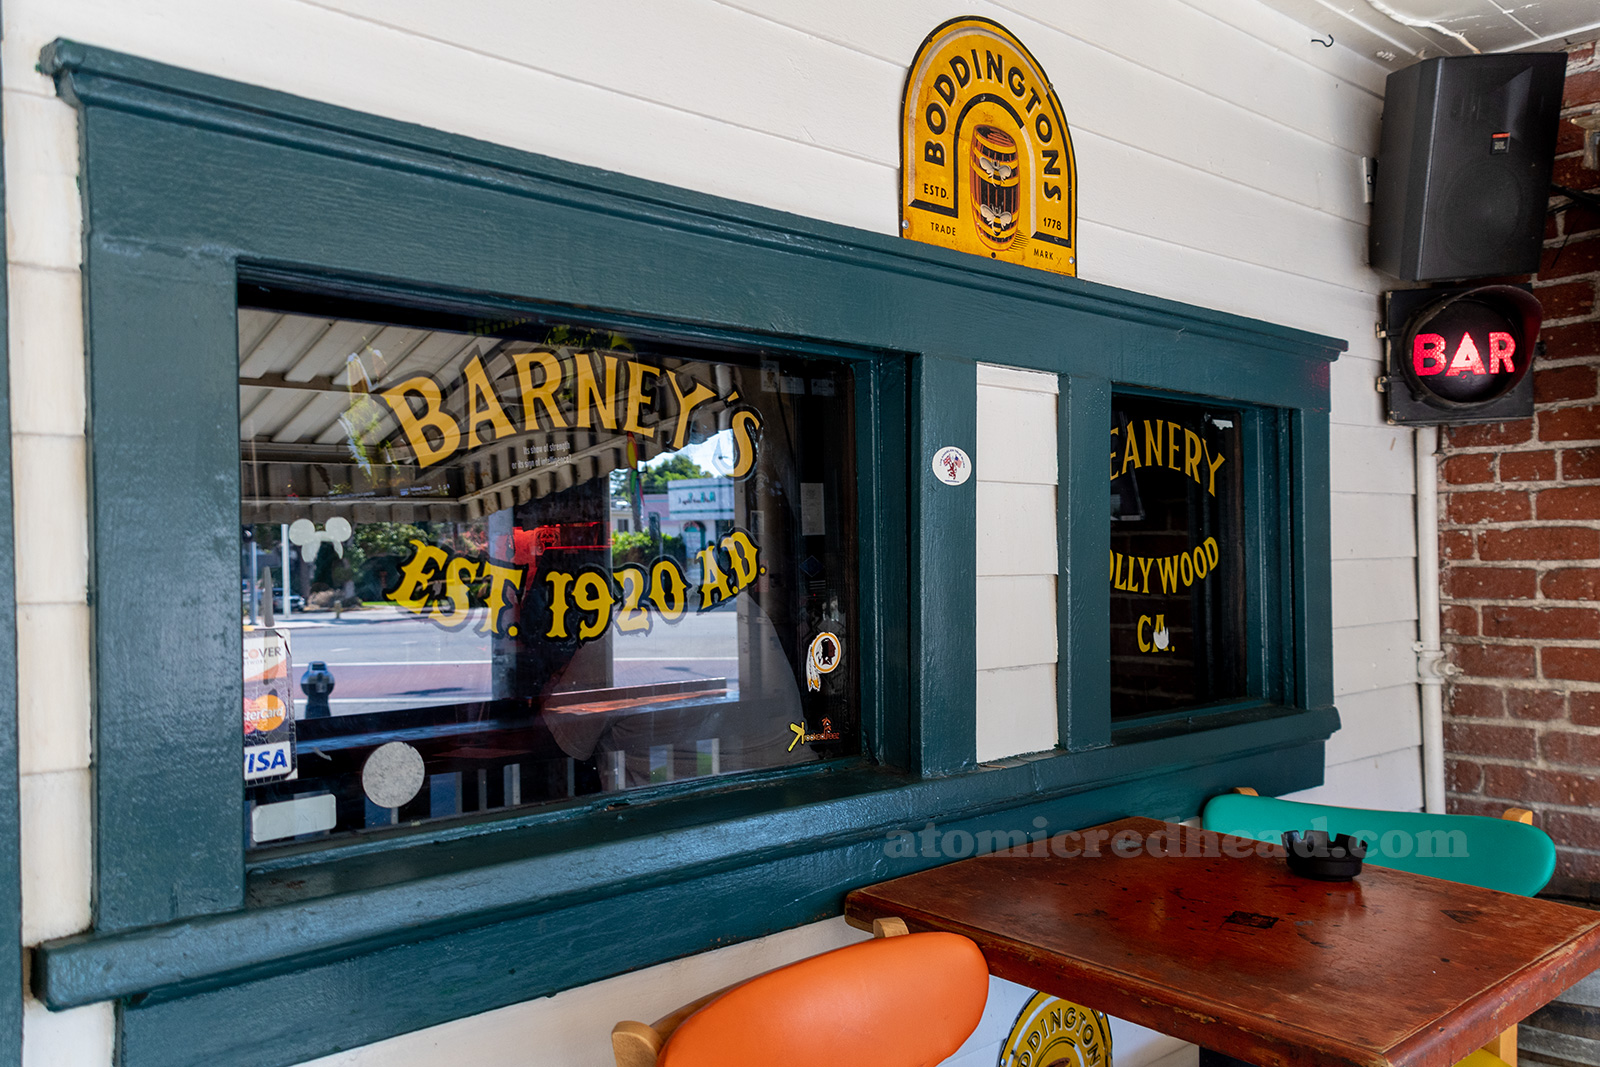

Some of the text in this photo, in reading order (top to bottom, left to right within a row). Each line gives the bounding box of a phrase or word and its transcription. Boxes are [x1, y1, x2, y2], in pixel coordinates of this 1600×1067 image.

[924, 48, 1061, 203] BODDINGTONS
[923, 182, 949, 200] ESTD.
[930, 221, 956, 236] TRADE
[1042, 217, 1062, 231] 1778
[1033, 248, 1054, 261] MARK
[1413, 331, 1516, 377] BAR
[380, 350, 761, 479] BARNEY'S
[543, 443, 549, 453] of
[387, 531, 766, 640] EST. 1920 A.D.
[244, 749, 288, 774] ISA
